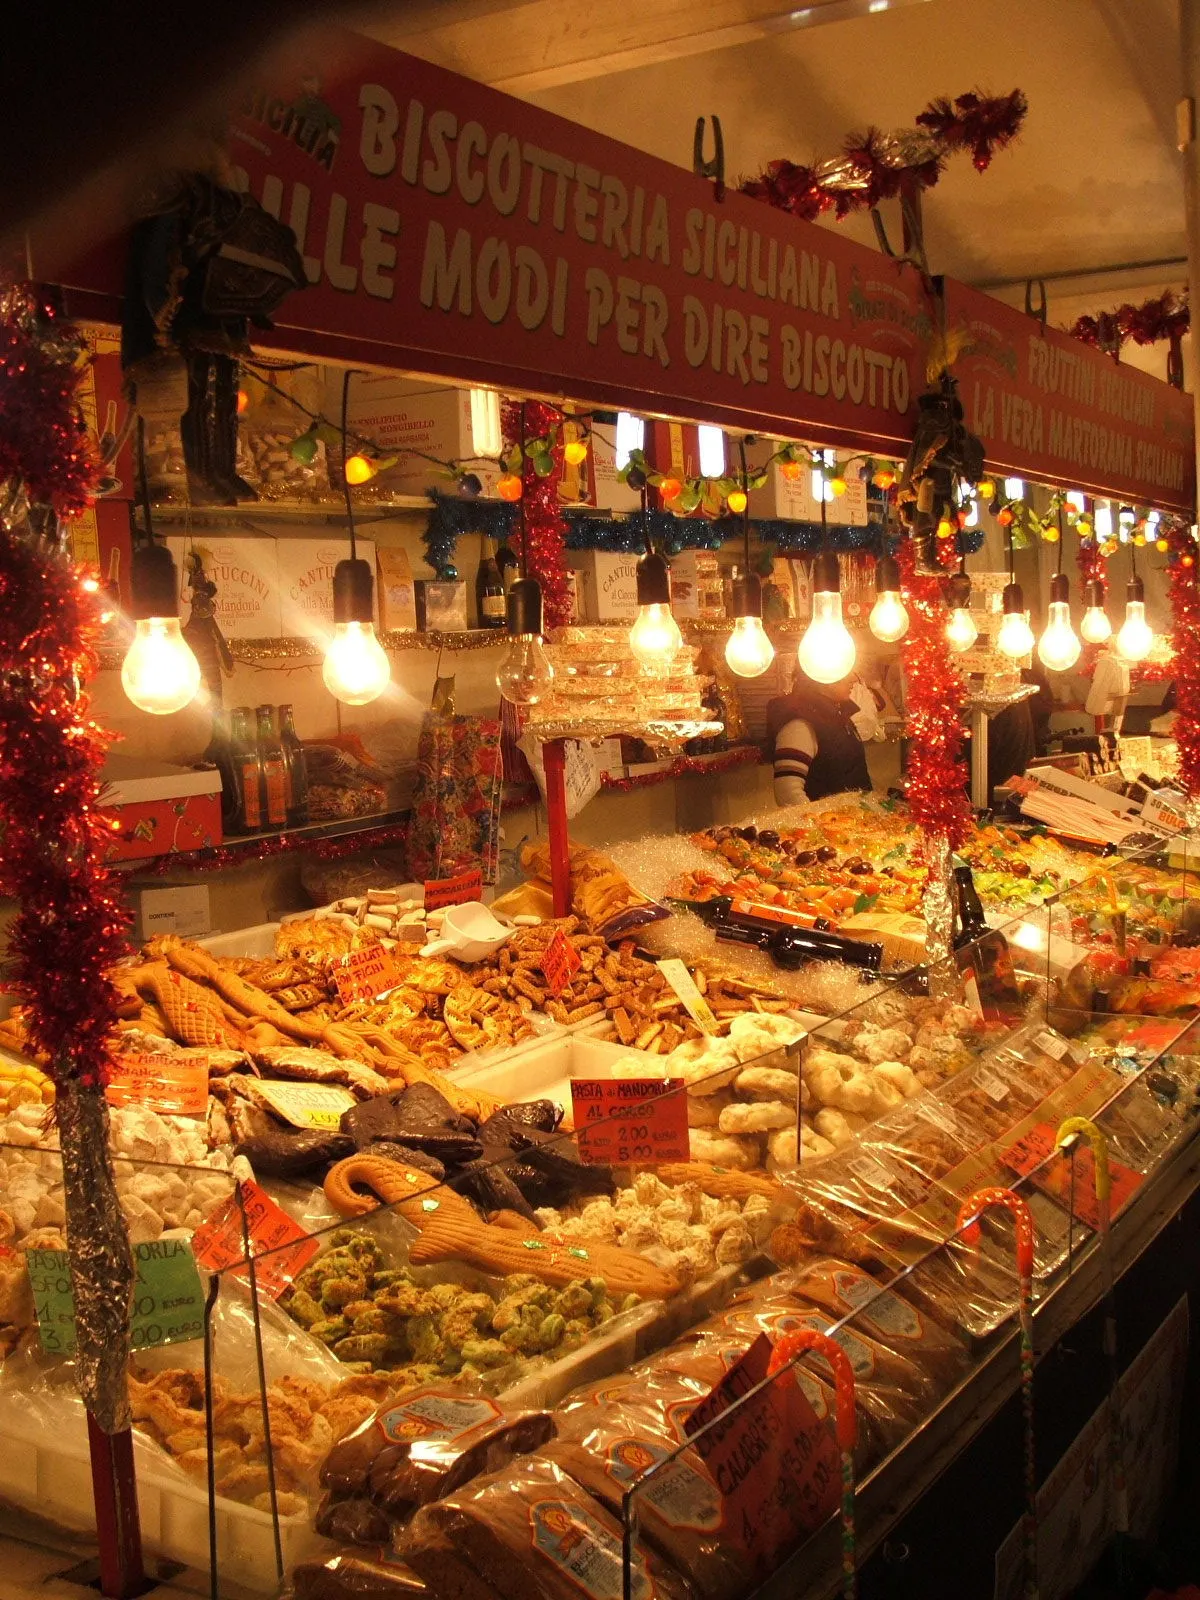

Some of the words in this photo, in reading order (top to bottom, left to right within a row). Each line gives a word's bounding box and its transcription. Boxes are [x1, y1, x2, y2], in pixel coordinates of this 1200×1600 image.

[358, 84, 671, 267] BISCOTTERIA
[682, 208, 839, 320] SICILIANA
[228, 166, 400, 300] ILLE
[420, 220, 568, 337] MODI
[585, 267, 670, 368] PER
[682, 295, 770, 385] DIRE
[781, 324, 909, 414] BISCOTTO
[973, 381, 996, 440] LA
[1001, 391, 1043, 455] VERA
[1048, 410, 1134, 477] MARTORANA
[572, 1082, 603, 1098] PASTA
[586, 1105, 603, 1118] AL
[43, 1328, 61, 1349] 3
